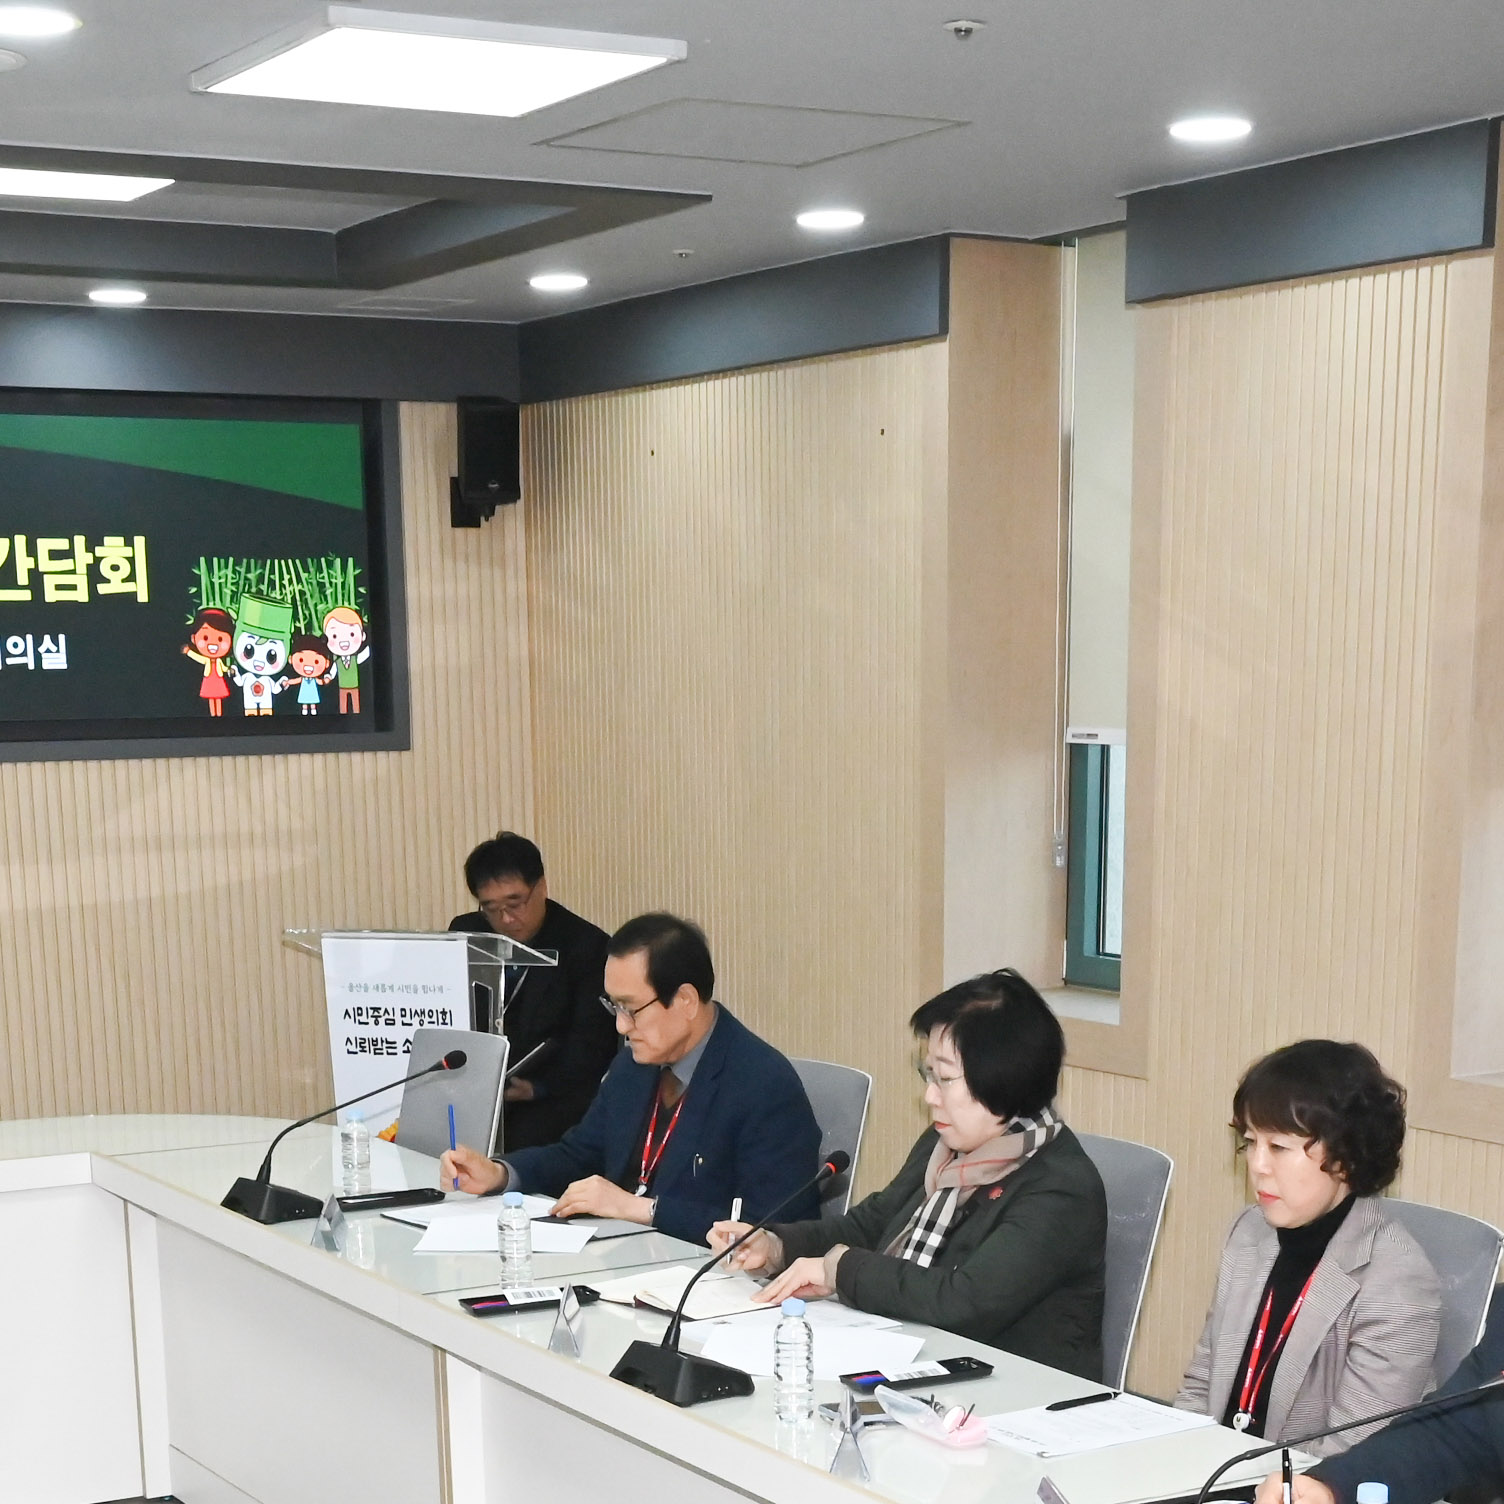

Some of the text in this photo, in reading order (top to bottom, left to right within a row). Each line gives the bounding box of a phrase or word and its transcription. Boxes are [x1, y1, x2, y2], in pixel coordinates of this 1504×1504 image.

[343, 1006, 453, 1027] 시민중심 민생의회
[345, 1036, 398, 1056] 신뢰받는
